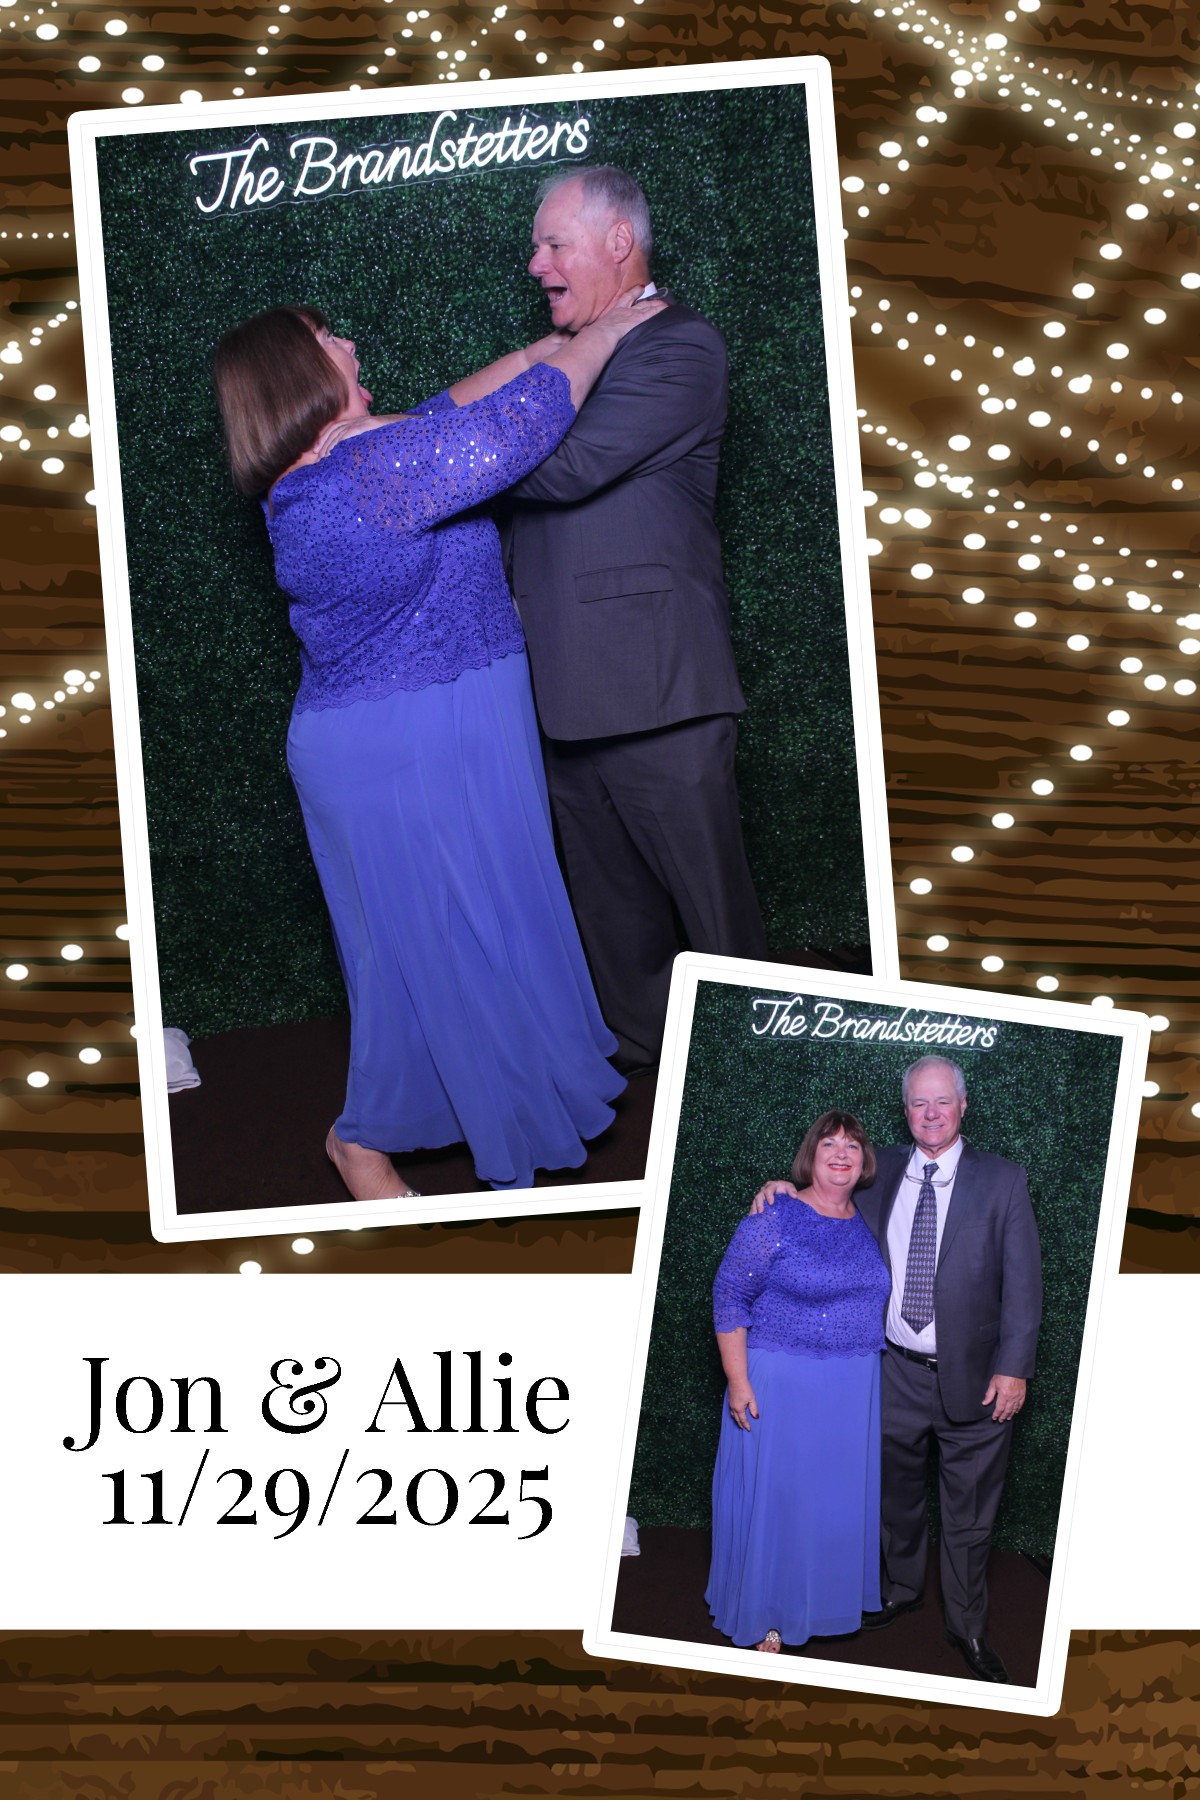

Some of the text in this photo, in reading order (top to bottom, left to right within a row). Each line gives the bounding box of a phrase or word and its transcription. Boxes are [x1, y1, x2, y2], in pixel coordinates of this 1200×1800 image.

[189, 110, 590, 213] The Brandstetters
[751, 996, 998, 1048] The Brandstetters
